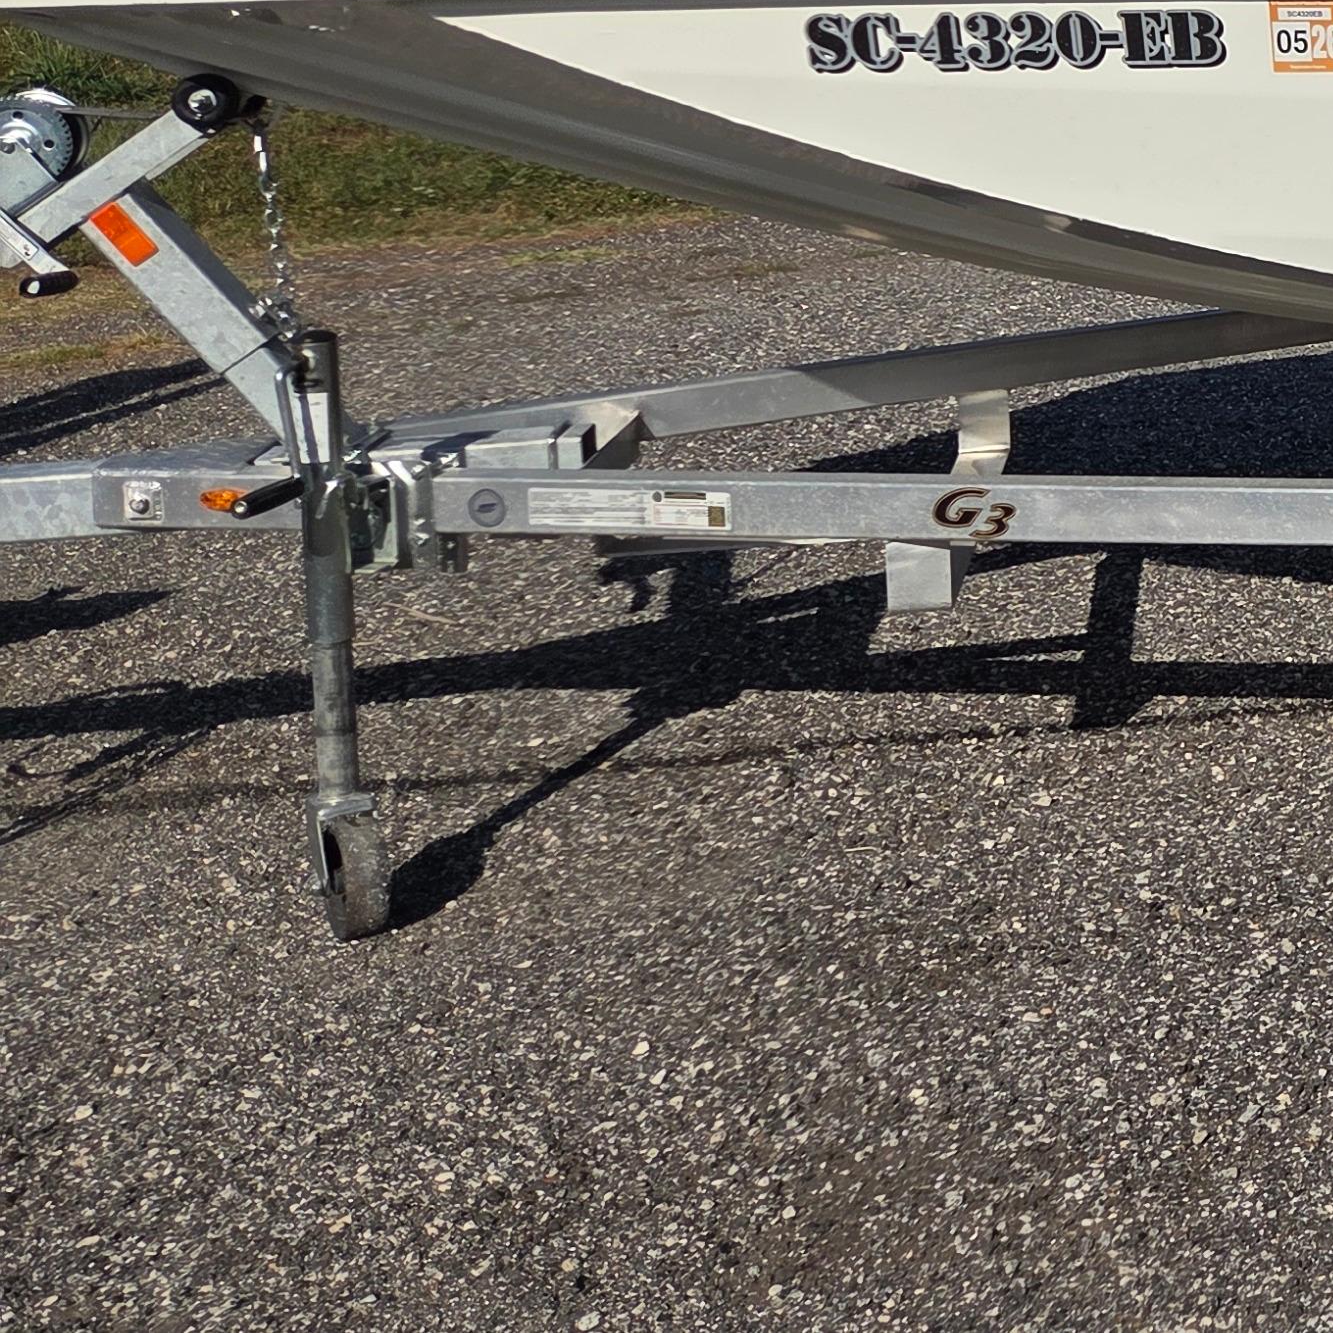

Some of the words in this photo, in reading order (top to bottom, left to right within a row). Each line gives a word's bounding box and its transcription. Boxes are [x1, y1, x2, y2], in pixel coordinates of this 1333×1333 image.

[1286, 10, 1323, 18] SC4320EB
[805, 10, 1228, 72] SC-4320-EB
[1276, 29, 1309, 54] 05
[931, 486, 1018, 539] G3
